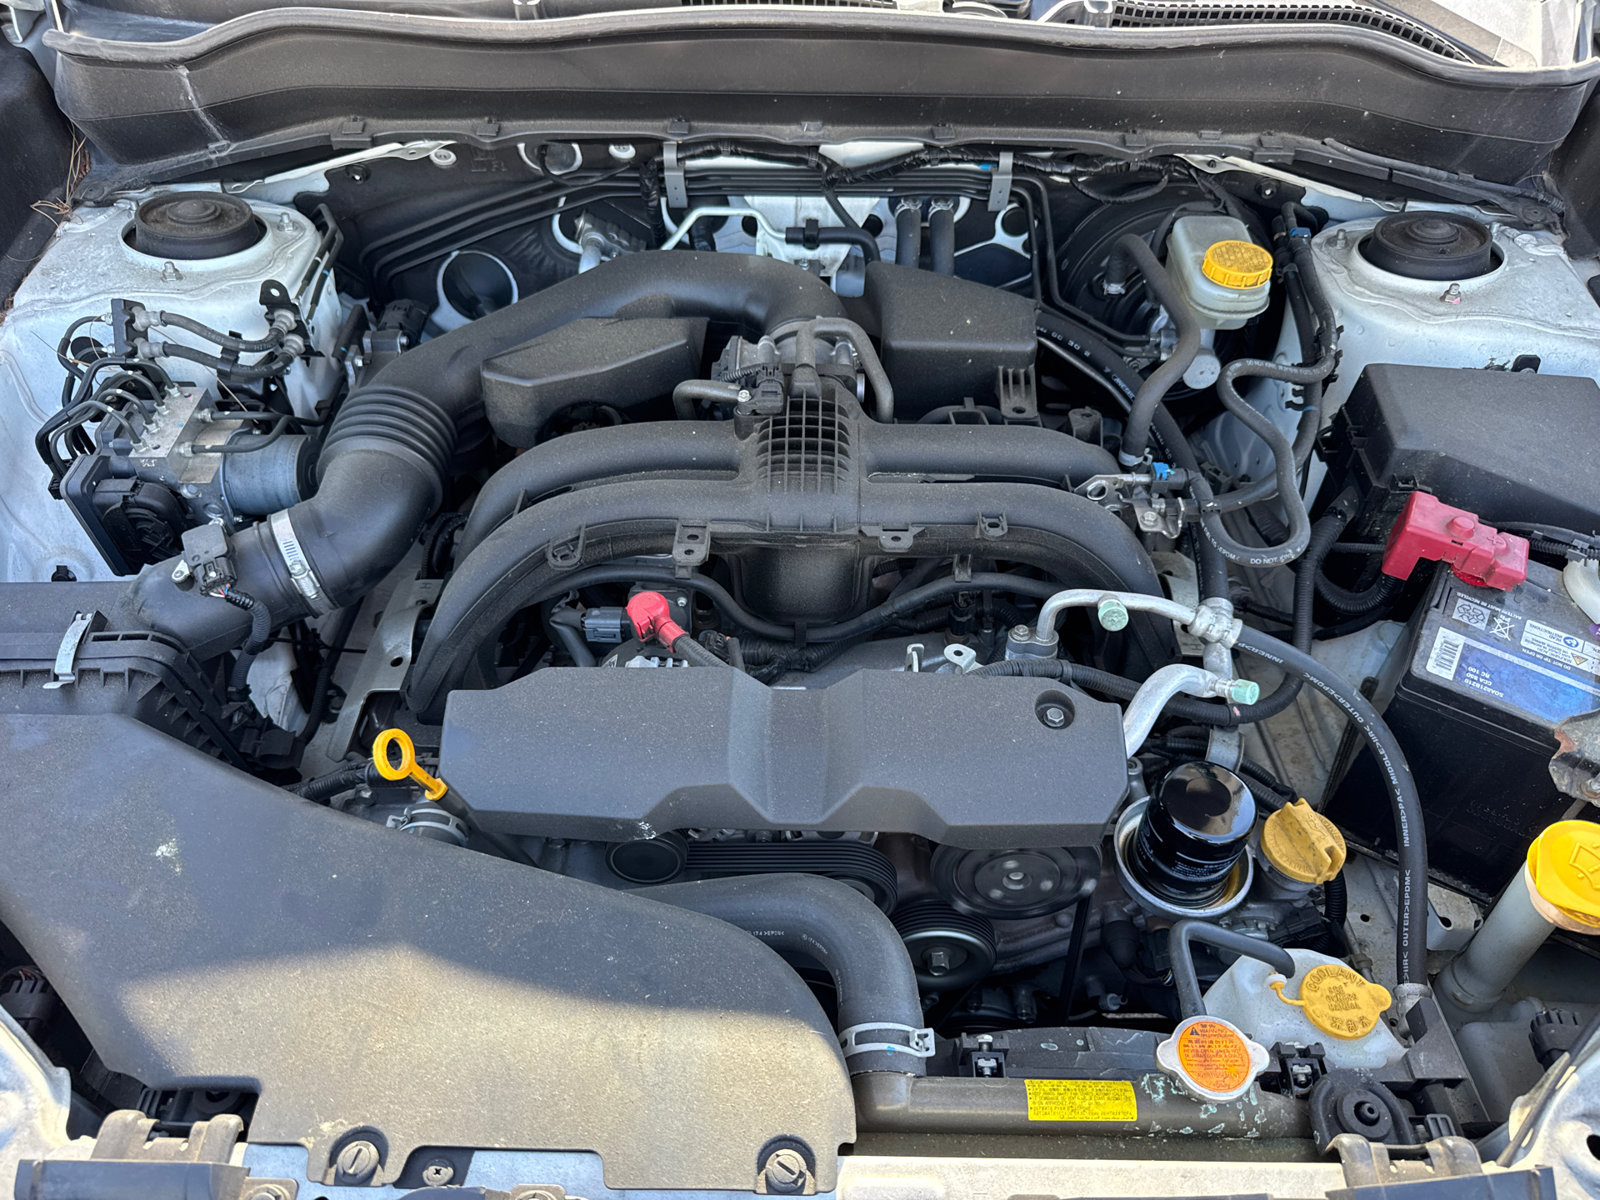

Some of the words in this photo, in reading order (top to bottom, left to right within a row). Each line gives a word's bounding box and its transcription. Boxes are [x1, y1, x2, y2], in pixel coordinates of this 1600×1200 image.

[1522, 648, 1536, 656] OPEN
[1468, 666, 1480, 674] 100
[1479, 677, 1492, 686] CCA
[1480, 671, 1490, 679] RC
[1303, 672, 1364, 723] OUTER>EPDM<
[1364, 725, 1398, 784] MIDDLE>IIR<
[1394, 788, 1410, 847] INNER>PA<
[1403, 869, 1411, 946] OUTER>EPDM<
[1306, 967, 1365, 992] COOLANT
